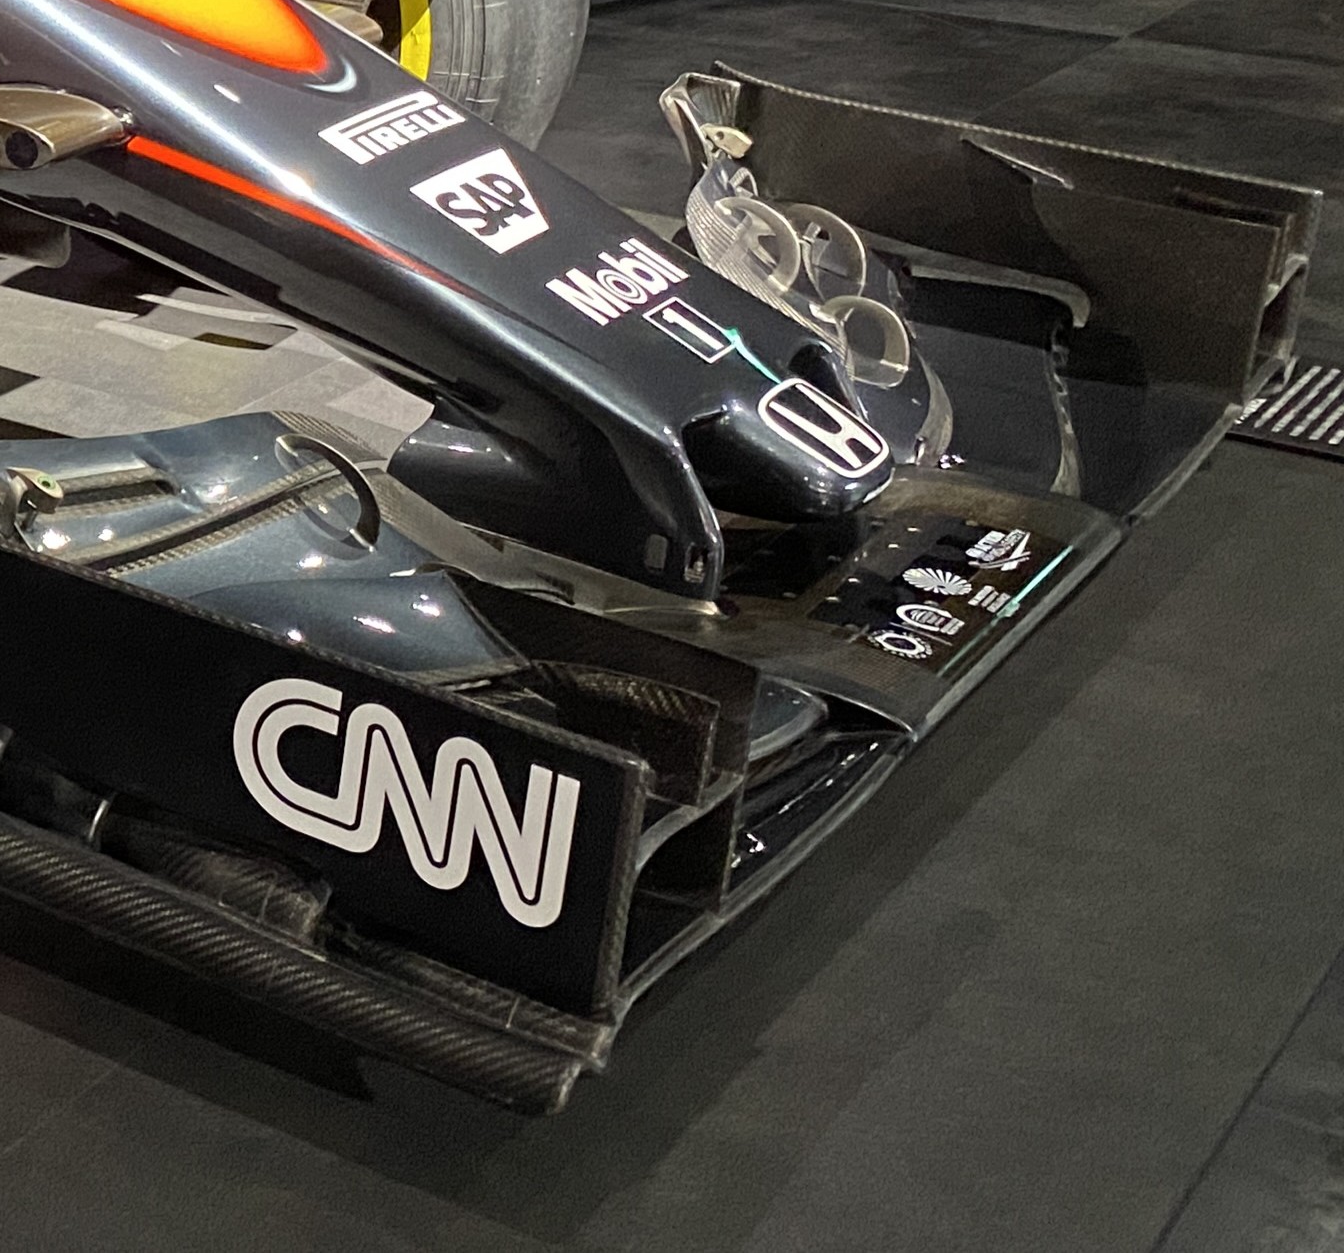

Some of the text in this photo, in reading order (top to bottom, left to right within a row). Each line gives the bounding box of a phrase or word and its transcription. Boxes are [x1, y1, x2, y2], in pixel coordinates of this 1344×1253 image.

[318, 91, 466, 165] PIRELLI
[436, 172, 535, 236] SAP
[545, 237, 690, 326] Mobil
[233, 678, 580, 929] CNN
